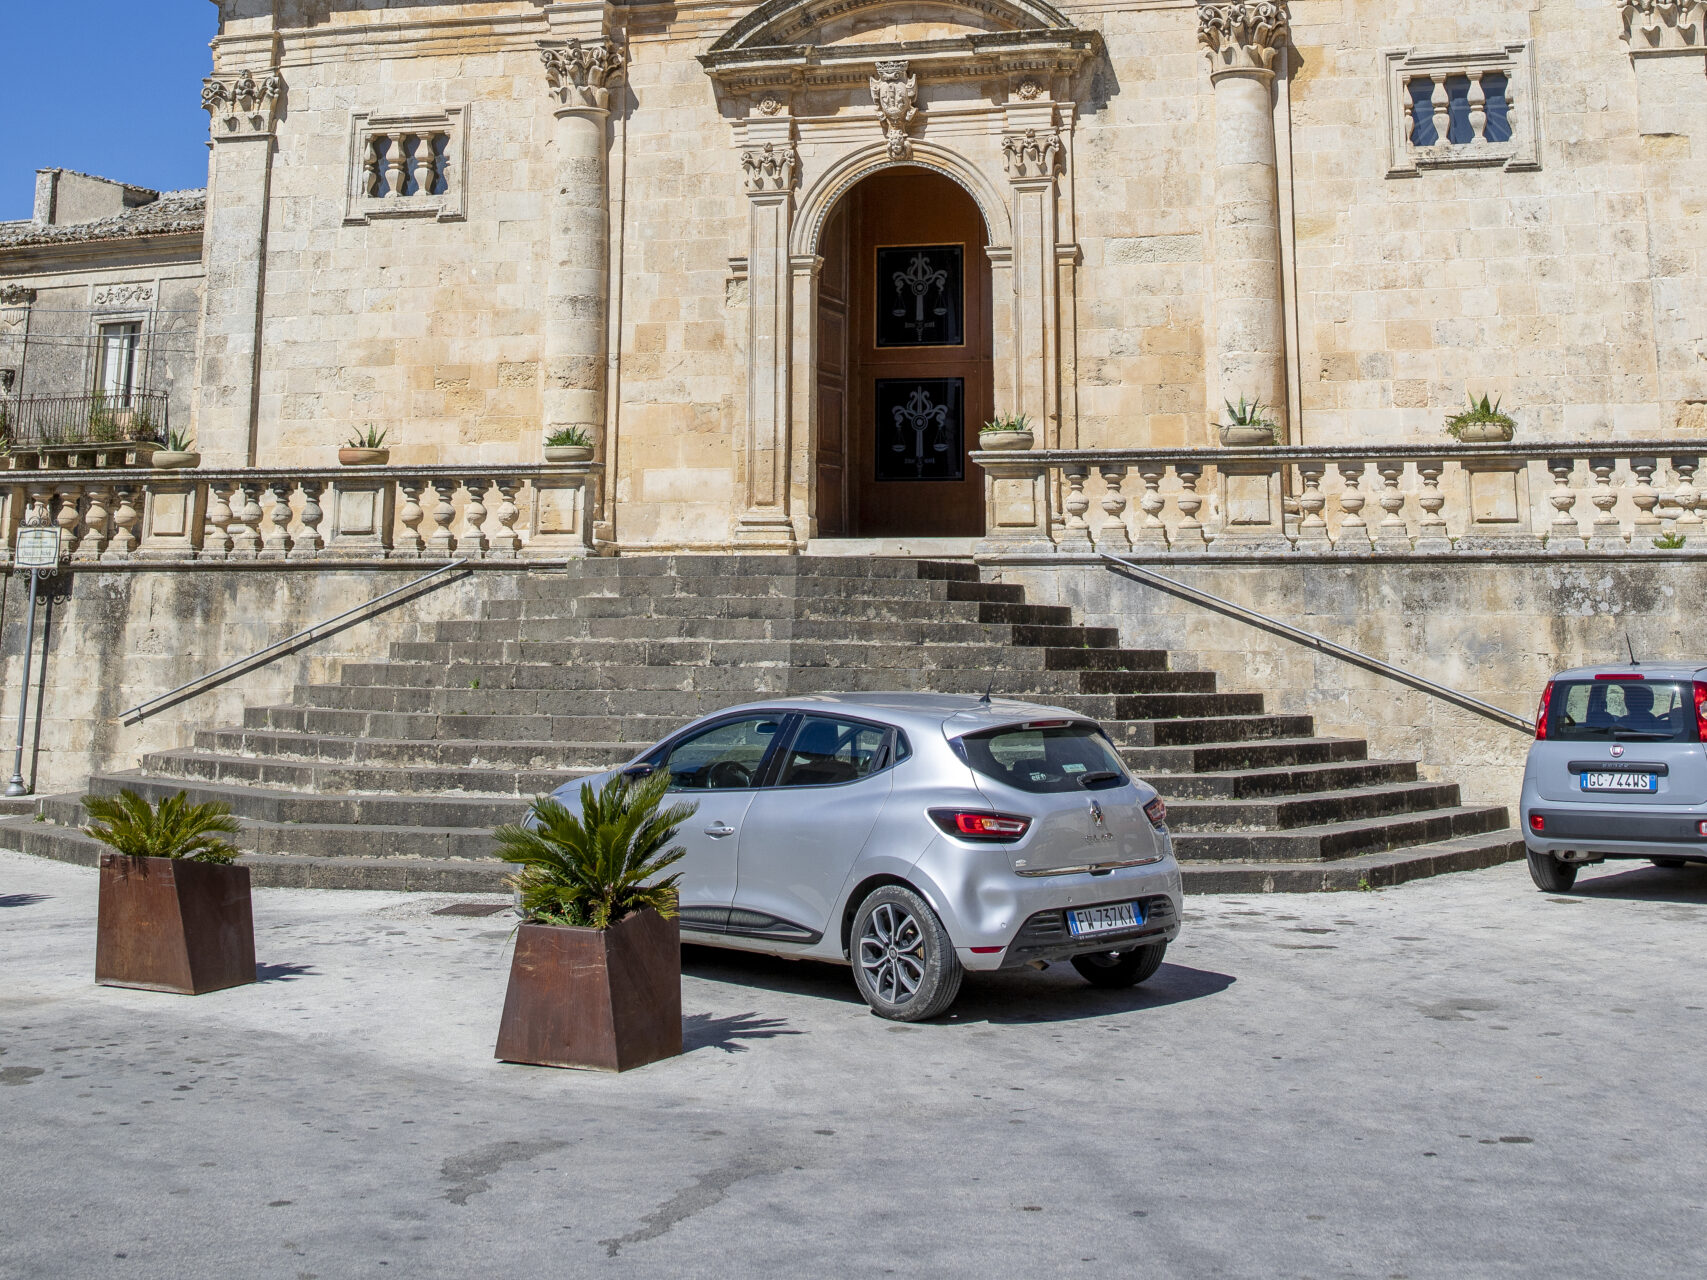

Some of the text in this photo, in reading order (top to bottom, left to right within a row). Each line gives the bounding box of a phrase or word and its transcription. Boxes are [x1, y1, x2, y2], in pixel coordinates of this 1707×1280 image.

[1589, 773, 1648, 788] GC 744WS
[1076, 904, 1135, 932] FW 737KX
